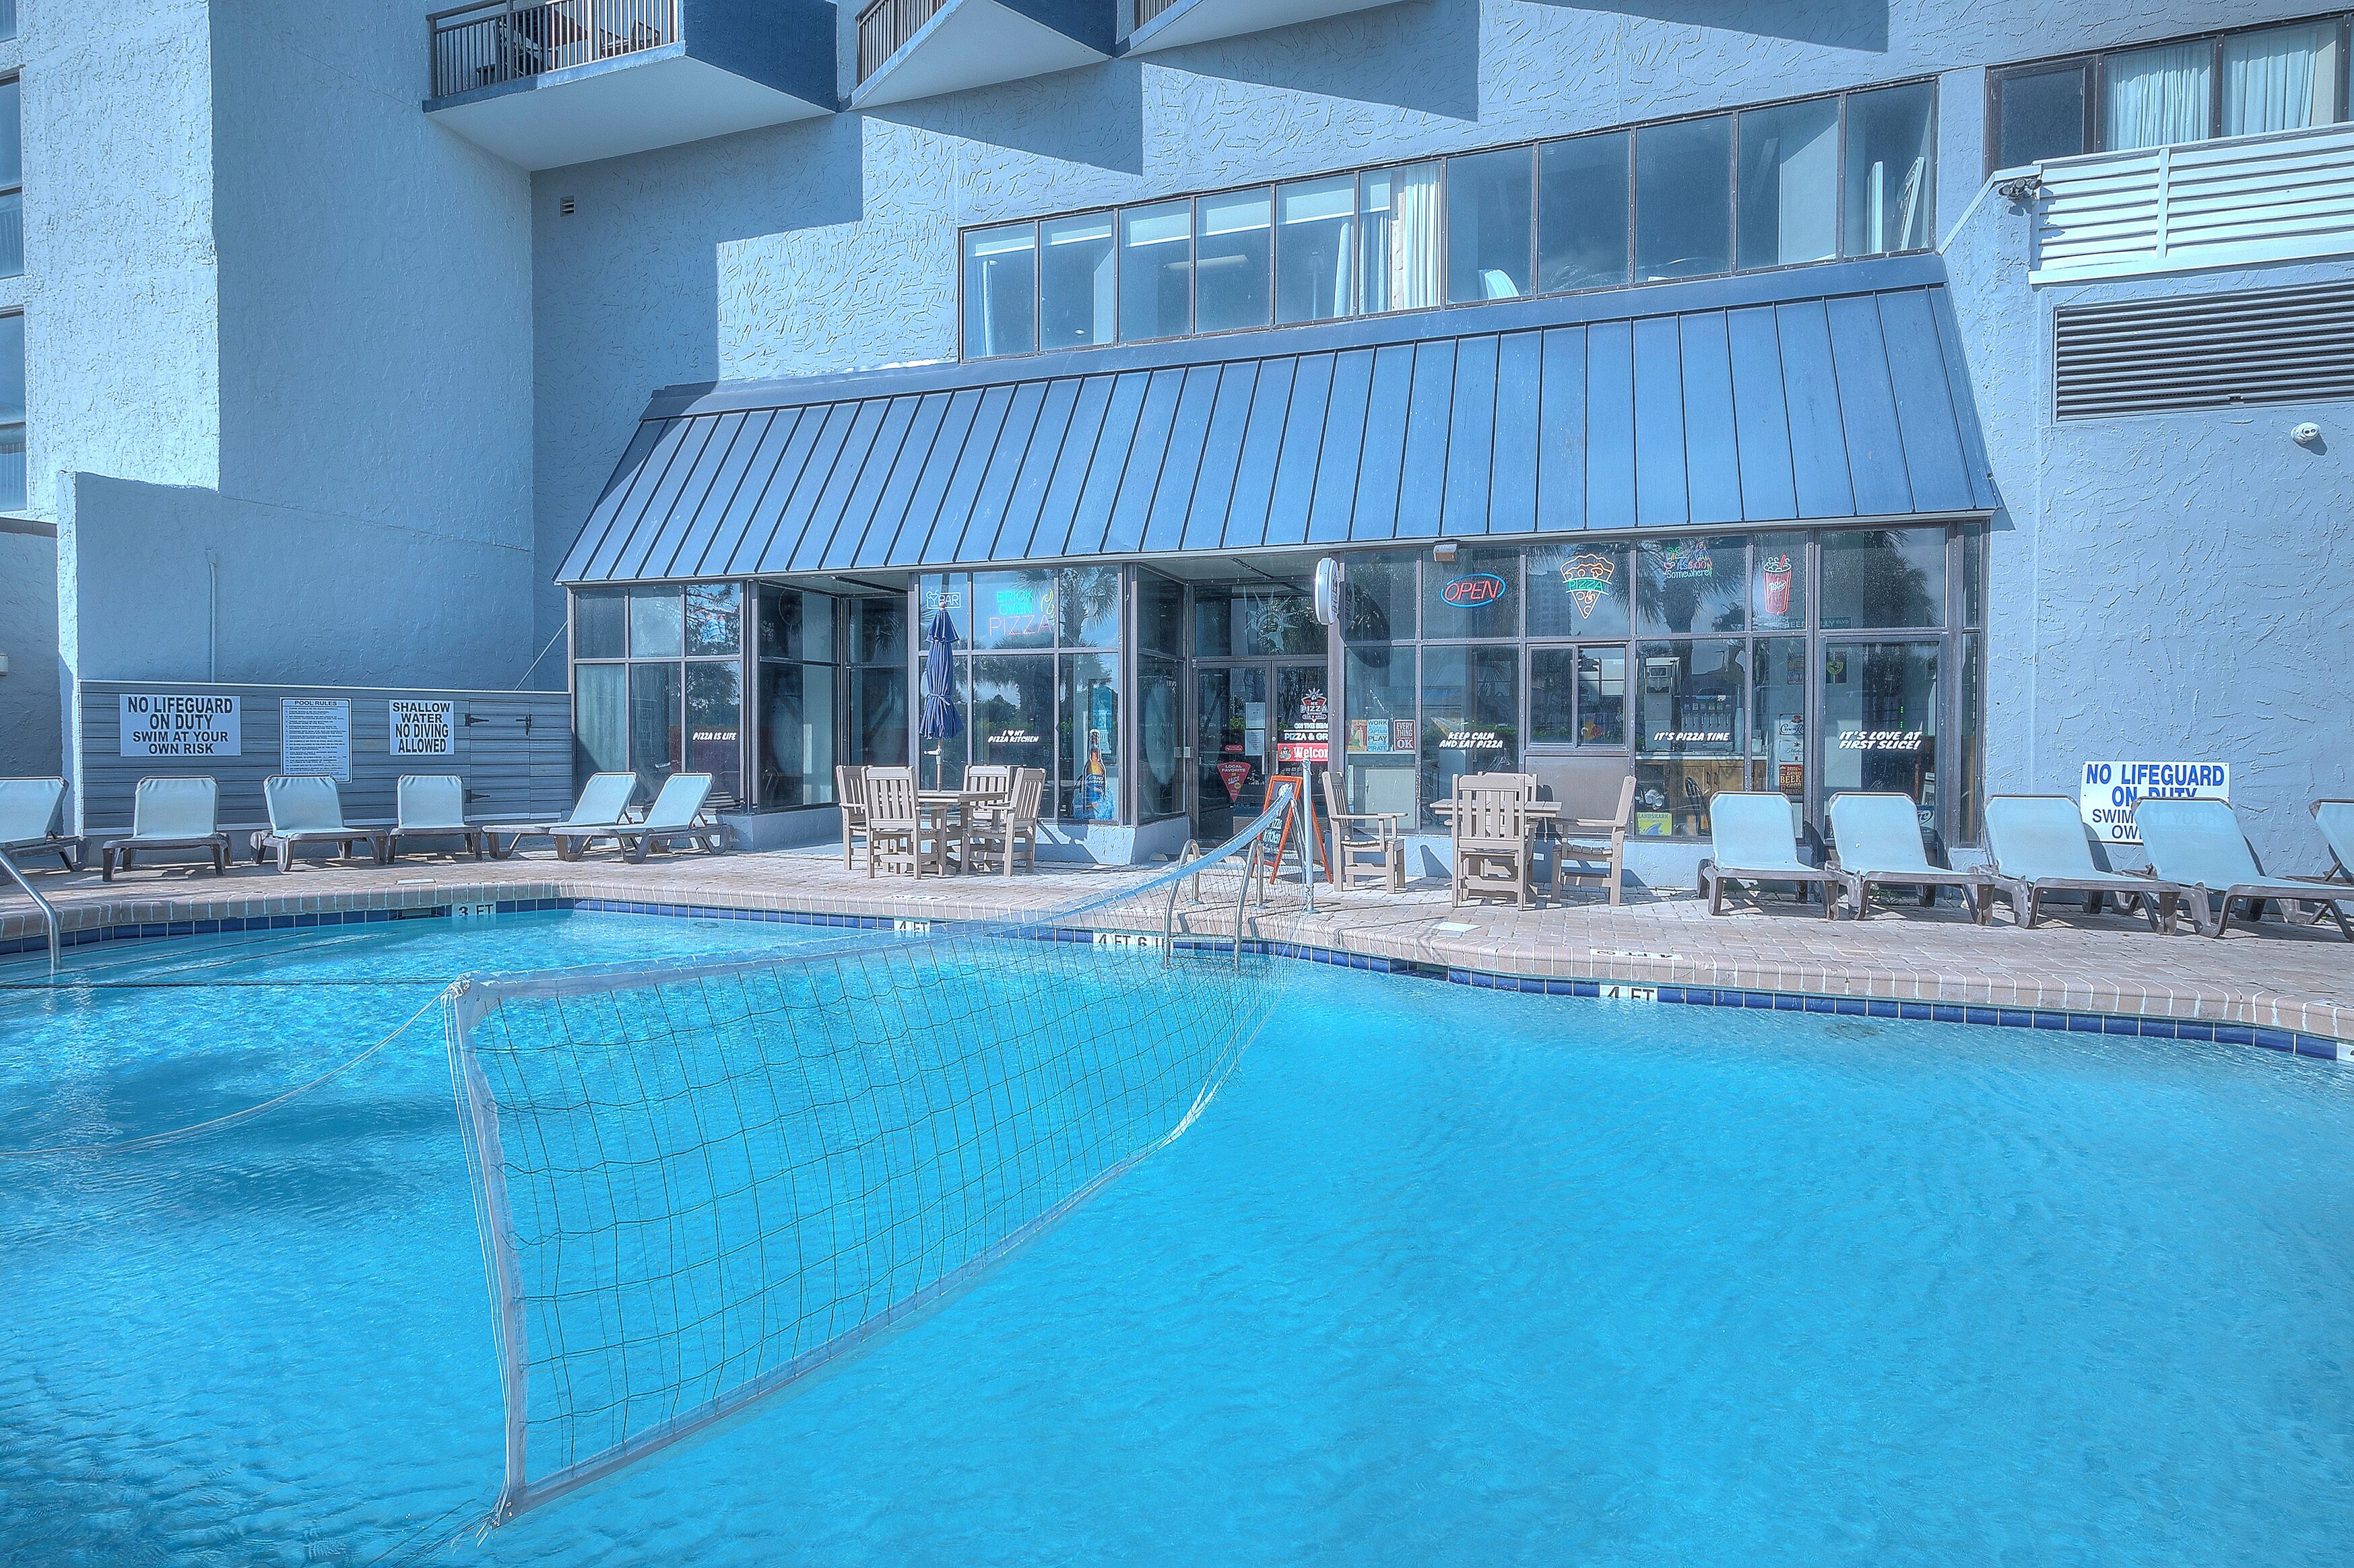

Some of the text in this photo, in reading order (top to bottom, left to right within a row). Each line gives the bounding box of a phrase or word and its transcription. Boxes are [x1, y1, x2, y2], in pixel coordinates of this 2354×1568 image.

[1688, 560, 1706, 570] 5:00
[1666, 569, 1709, 579] Somewhere
[1445, 580, 1500, 601] OPEN
[1569, 579, 1604, 591] PIZZA
[938, 595, 959, 606] BAR
[996, 589, 1034, 603] BRICK
[999, 603, 1033, 615] OVEN
[989, 614, 1053, 636] PIZZA
[128, 696, 232, 714] NO LIFEGUARD
[393, 702, 451, 713] SHALLOW
[150, 713, 214, 729] ON DUTY
[401, 713, 443, 723] WATER
[395, 723, 449, 738] NO DIVING
[692, 731, 737, 740] PIZZA IS LIFE
[1447, 731, 1495, 740] KEEP CALM
[1654, 731, 1730, 741] IT'S PIZZA TIME
[1839, 731, 1923, 740] IT'S LOVE AT
[133, 731, 229, 742] SWIM AT YOUR
[1284, 732, 1307, 741] PIZZA
[1307, 732, 1315, 741] &
[149, 743, 215, 754] OWN RISK
[398, 738, 447, 753] ALLOWED
[1396, 740, 1414, 748] OK
[1439, 740, 1503, 748] AND EAT PIZZA
[1839, 740, 1922, 750] FIRST SLICE!
[1780, 775, 1801, 783] BEER
[2086, 763, 2225, 786] NO LIFEGUARD
[2112, 786, 2137, 807] ON
[2092, 809, 2134, 823] SWIM
[2112, 825, 2143, 839] OW
[459, 904, 494, 916] 3 FT
[899, 921, 928, 932] 4 FT
[1099, 934, 1107, 944] 4
[1115, 934, 1131, 945] FT
[1138, 936, 1147, 947] 6
[1607, 986, 1655, 1001] 4 FT
